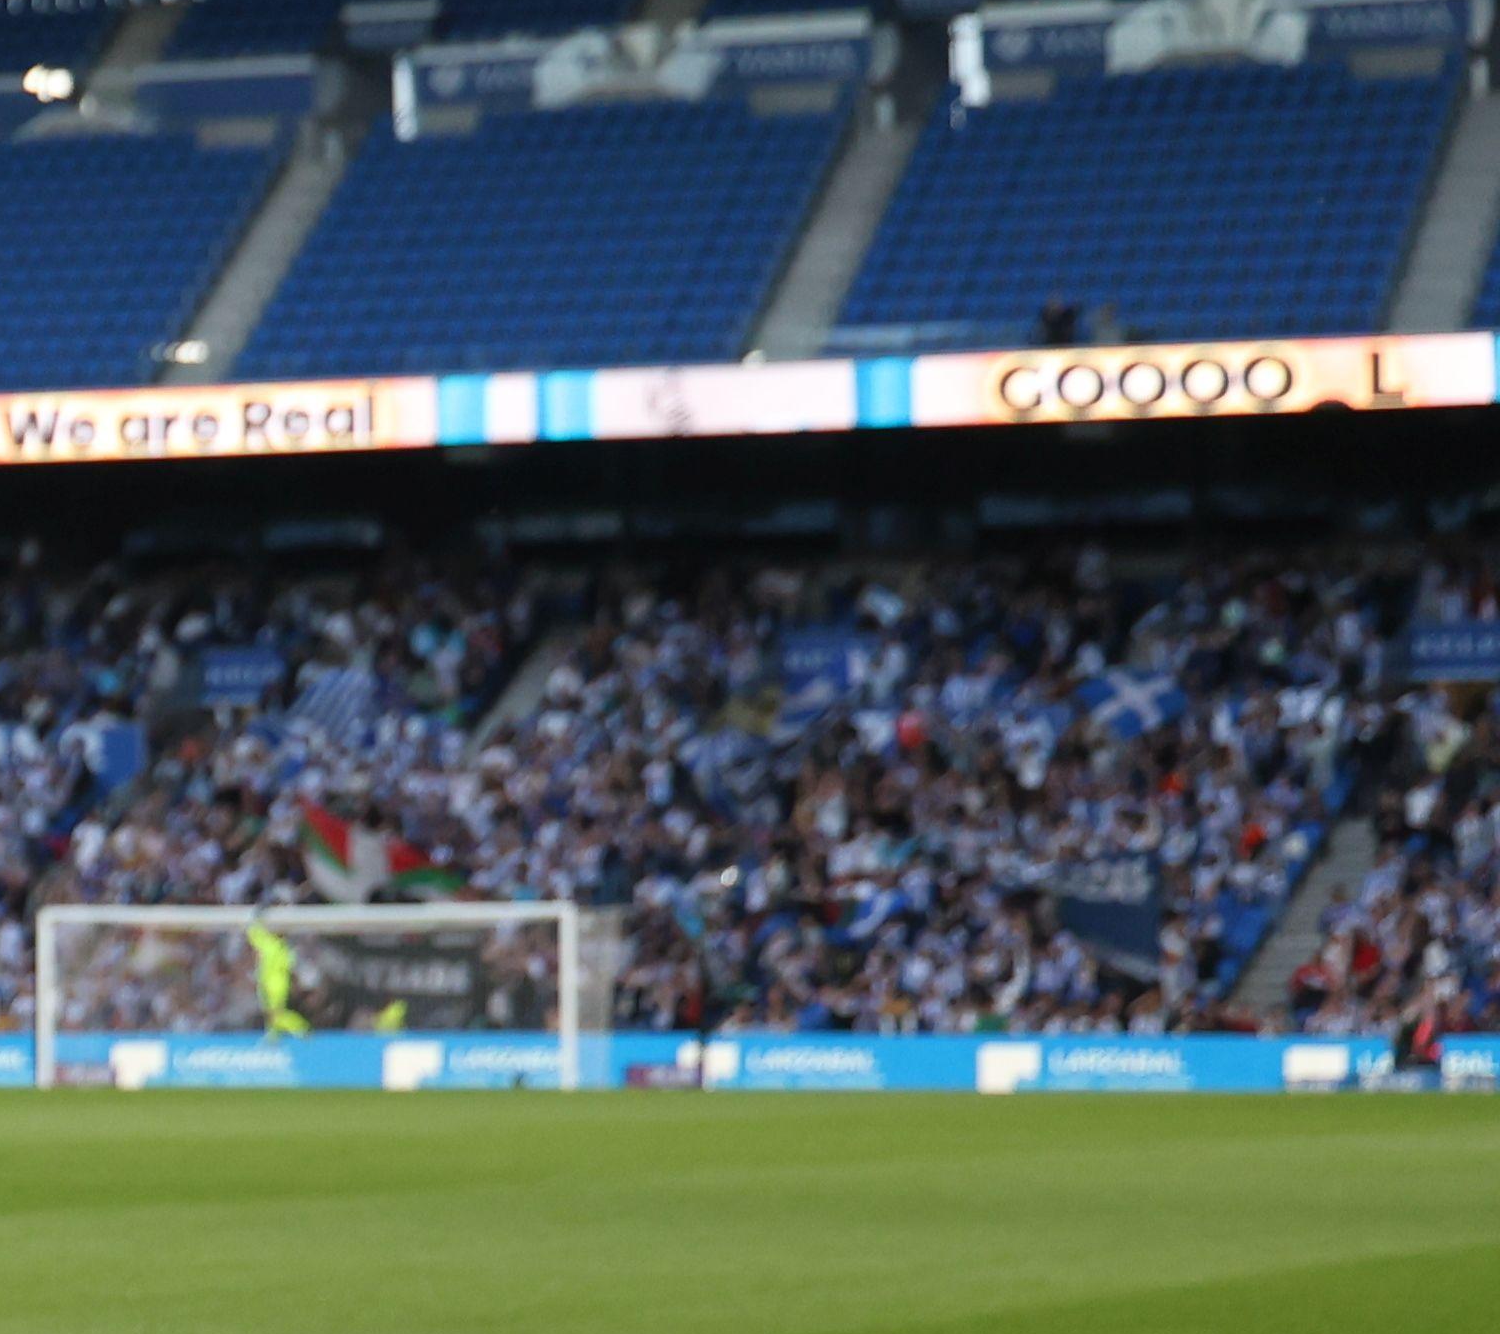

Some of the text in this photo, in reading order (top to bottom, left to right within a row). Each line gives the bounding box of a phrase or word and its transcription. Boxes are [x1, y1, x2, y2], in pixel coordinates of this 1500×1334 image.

[7, 395, 373, 448] We are Real
